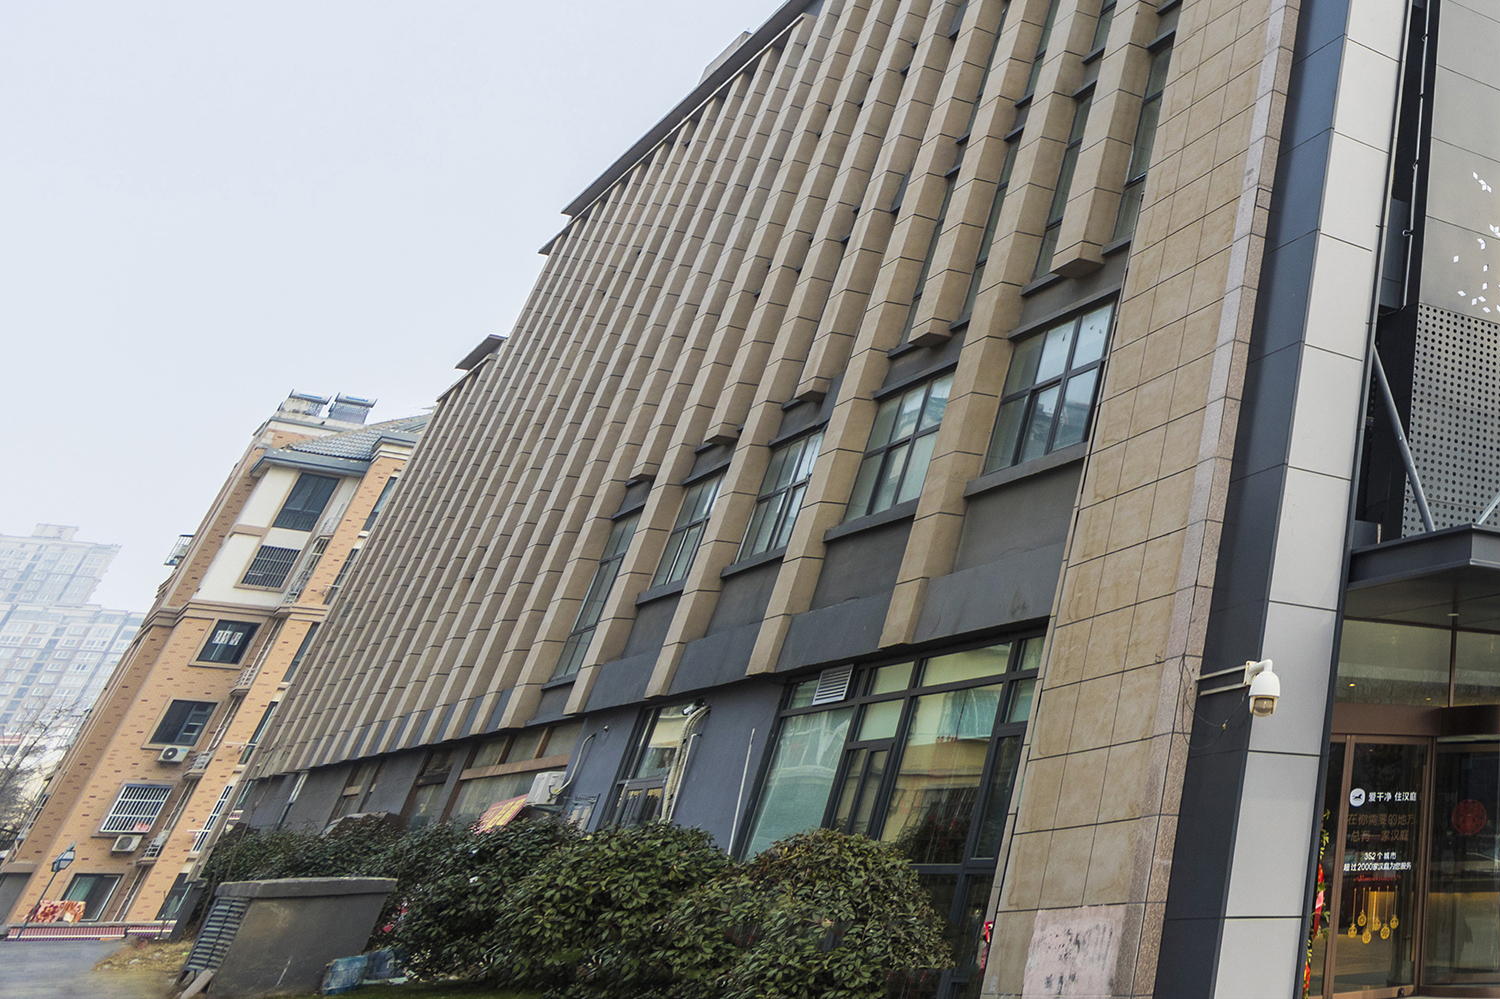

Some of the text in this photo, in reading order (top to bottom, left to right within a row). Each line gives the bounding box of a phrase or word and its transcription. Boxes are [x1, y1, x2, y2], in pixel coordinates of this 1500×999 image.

[1368, 791, 1417, 802] 爱干净 住汉庭
